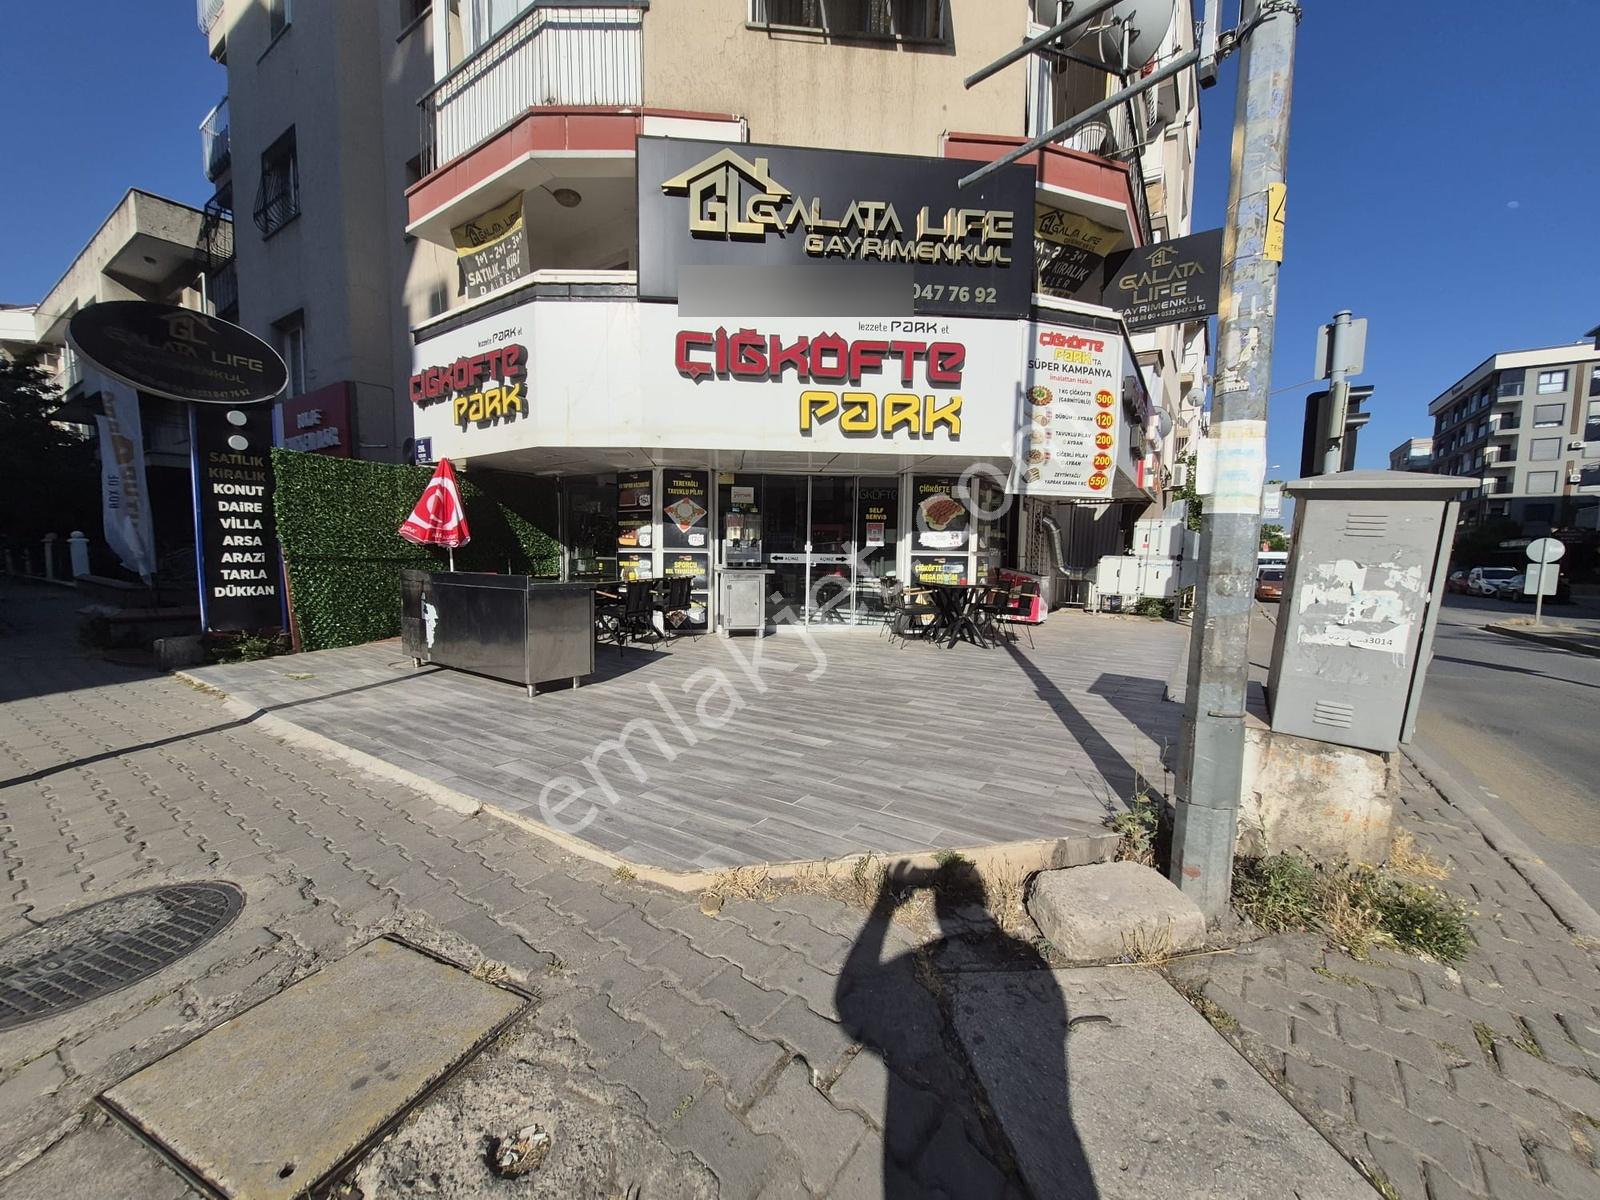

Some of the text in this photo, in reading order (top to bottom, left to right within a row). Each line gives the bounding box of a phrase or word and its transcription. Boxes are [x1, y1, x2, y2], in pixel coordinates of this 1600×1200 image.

[747, 195, 1014, 242] GALATA LIFE
[1118, 261, 1205, 290] GALATA
[948, 286, 970, 303] 76
[974, 287, 997, 304] 92
[1132, 280, 1188, 305] LIFE
[1027, 358, 1113, 379] SÜPER KAMPANYA
[1096, 394, 1113, 404] 500
[1096, 414, 1113, 426] 120
[1096, 435, 1112, 445] 200
[208, 451, 264, 468] SATILIK
[1094, 456, 1110, 466] 200
[208, 467, 267, 482] KİRALIK
[1089, 477, 1107, 485] 550
[213, 483, 265, 497] KONUT
[218, 501, 263, 513] DAİRE
[219, 516, 263, 530] VİLLA
[222, 535, 263, 547] ARSA
[221, 552, 265, 564] ARAZİ
[220, 569, 268, 580] TARLA
[214, 584, 275, 598] DÜKKAN
